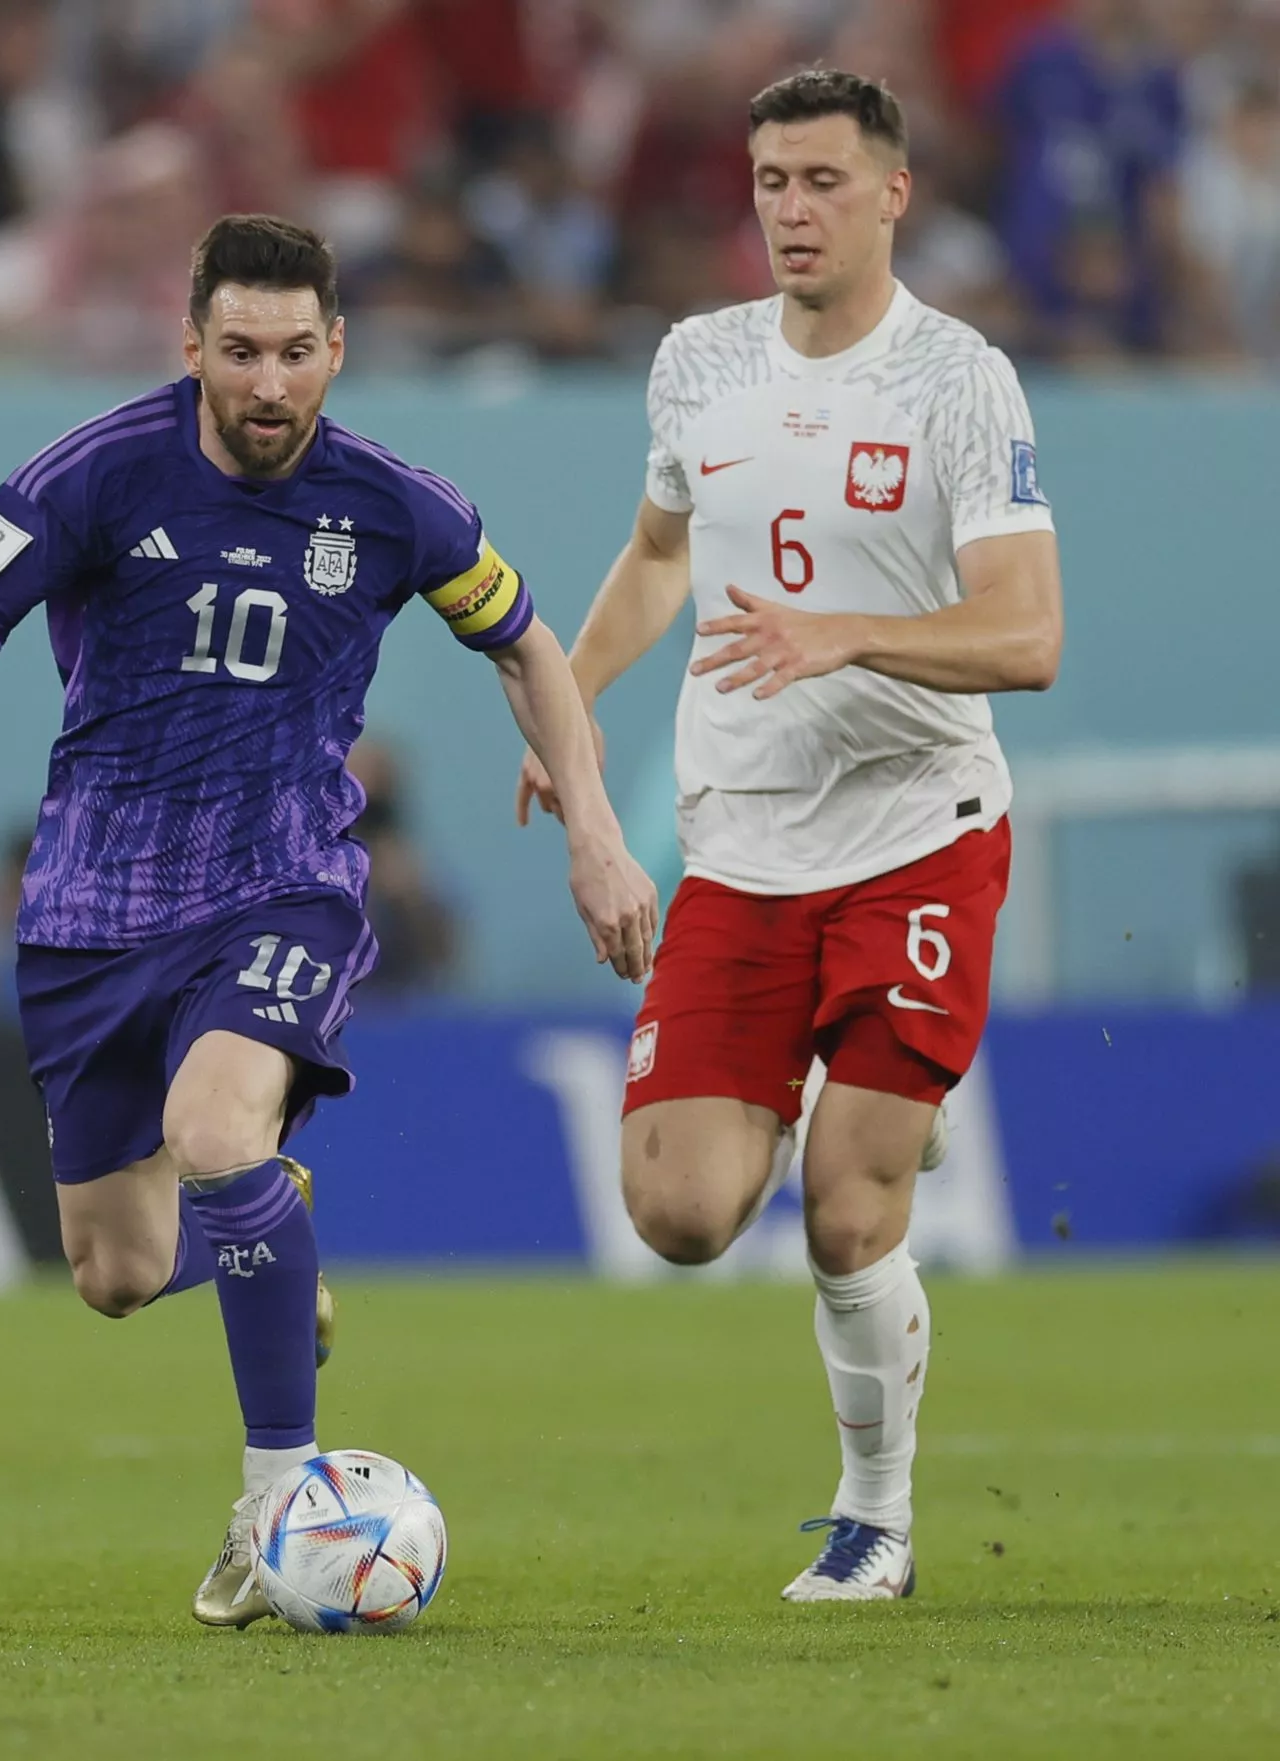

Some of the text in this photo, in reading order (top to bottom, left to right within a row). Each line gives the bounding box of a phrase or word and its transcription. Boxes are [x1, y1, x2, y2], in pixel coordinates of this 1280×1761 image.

[316, 548, 344, 578] AFA
[771, 509, 813, 593] 6
[181, 583, 288, 682] 10
[237, 934, 331, 1001] 10
[907, 903, 952, 981] 6
